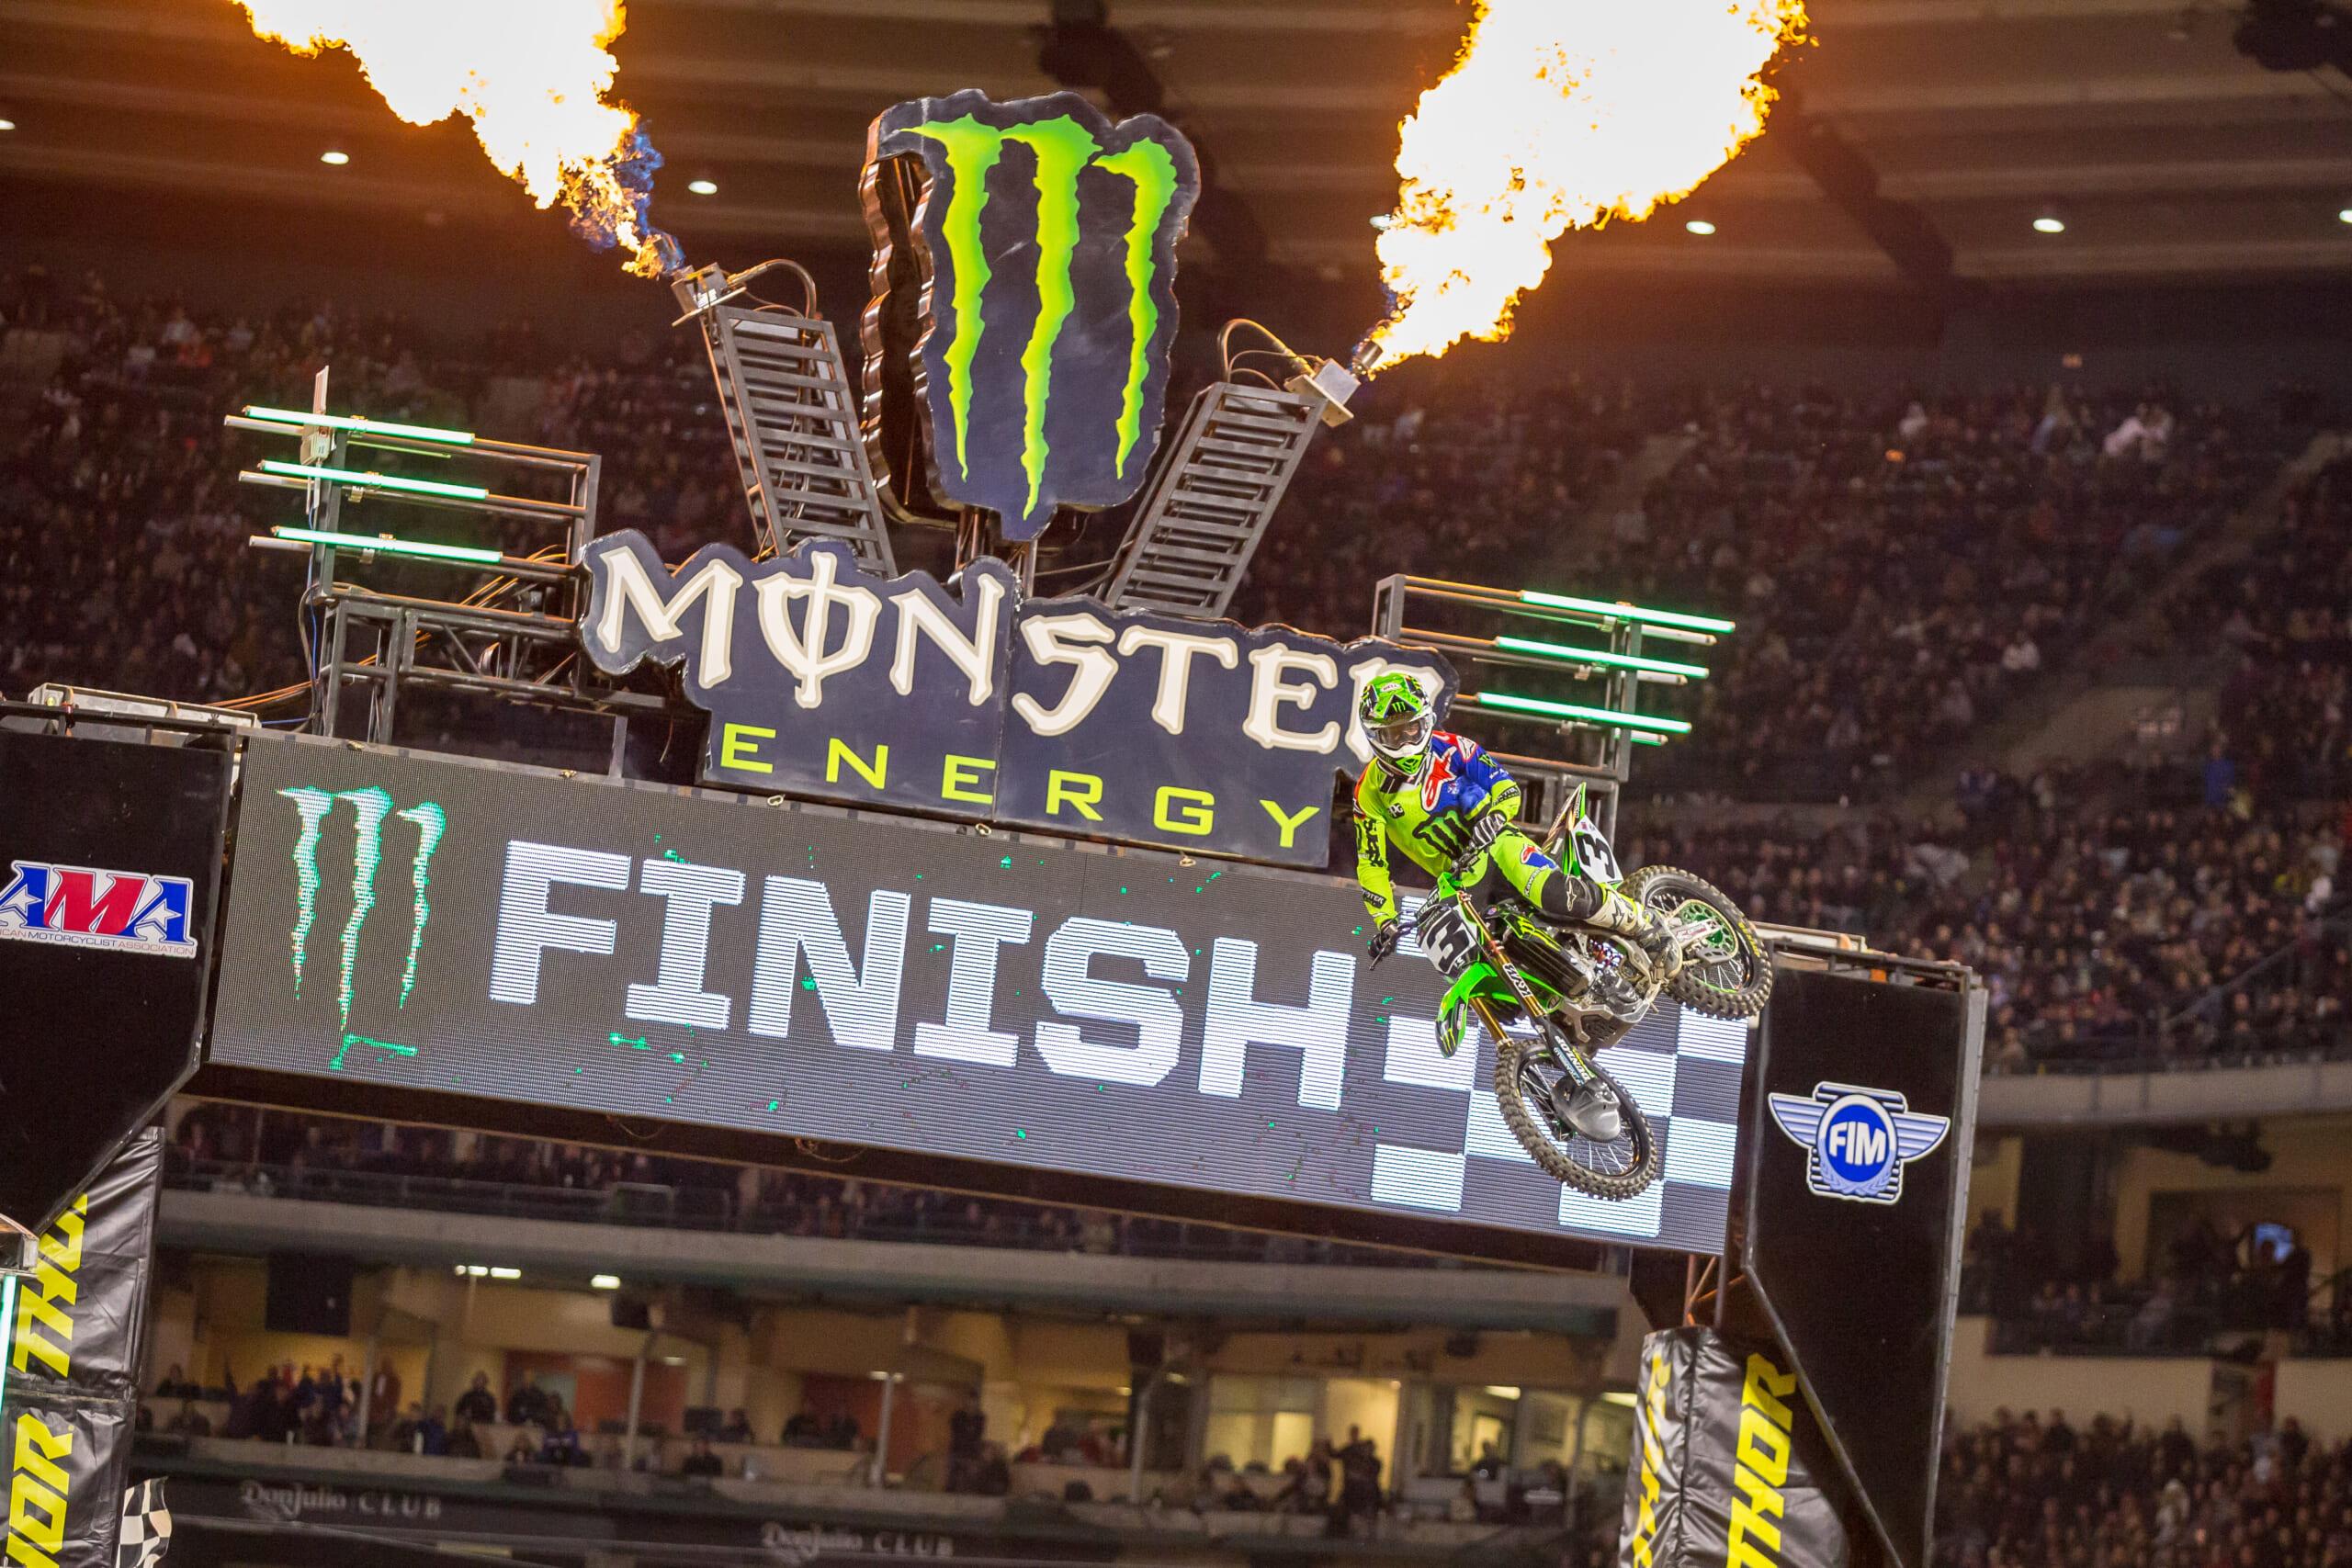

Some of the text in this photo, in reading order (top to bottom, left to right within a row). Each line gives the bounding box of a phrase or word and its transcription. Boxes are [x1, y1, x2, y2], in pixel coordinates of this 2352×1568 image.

[721, 723, 1320, 848] ENERGY
[1575, 832, 1615, 879] 3
[0, 864, 195, 946] AMA
[28, 931, 118, 947] MOTORCYCLIST
[118, 941, 194, 955] ASSOCIATION
[1426, 909, 1471, 974] 3
[489, 840, 1357, 1111] FINISH
[1829, 1121, 1887, 1167] FIM
[13, 1194, 88, 1378] THO
[1727, 1352, 1796, 1568] THOR
